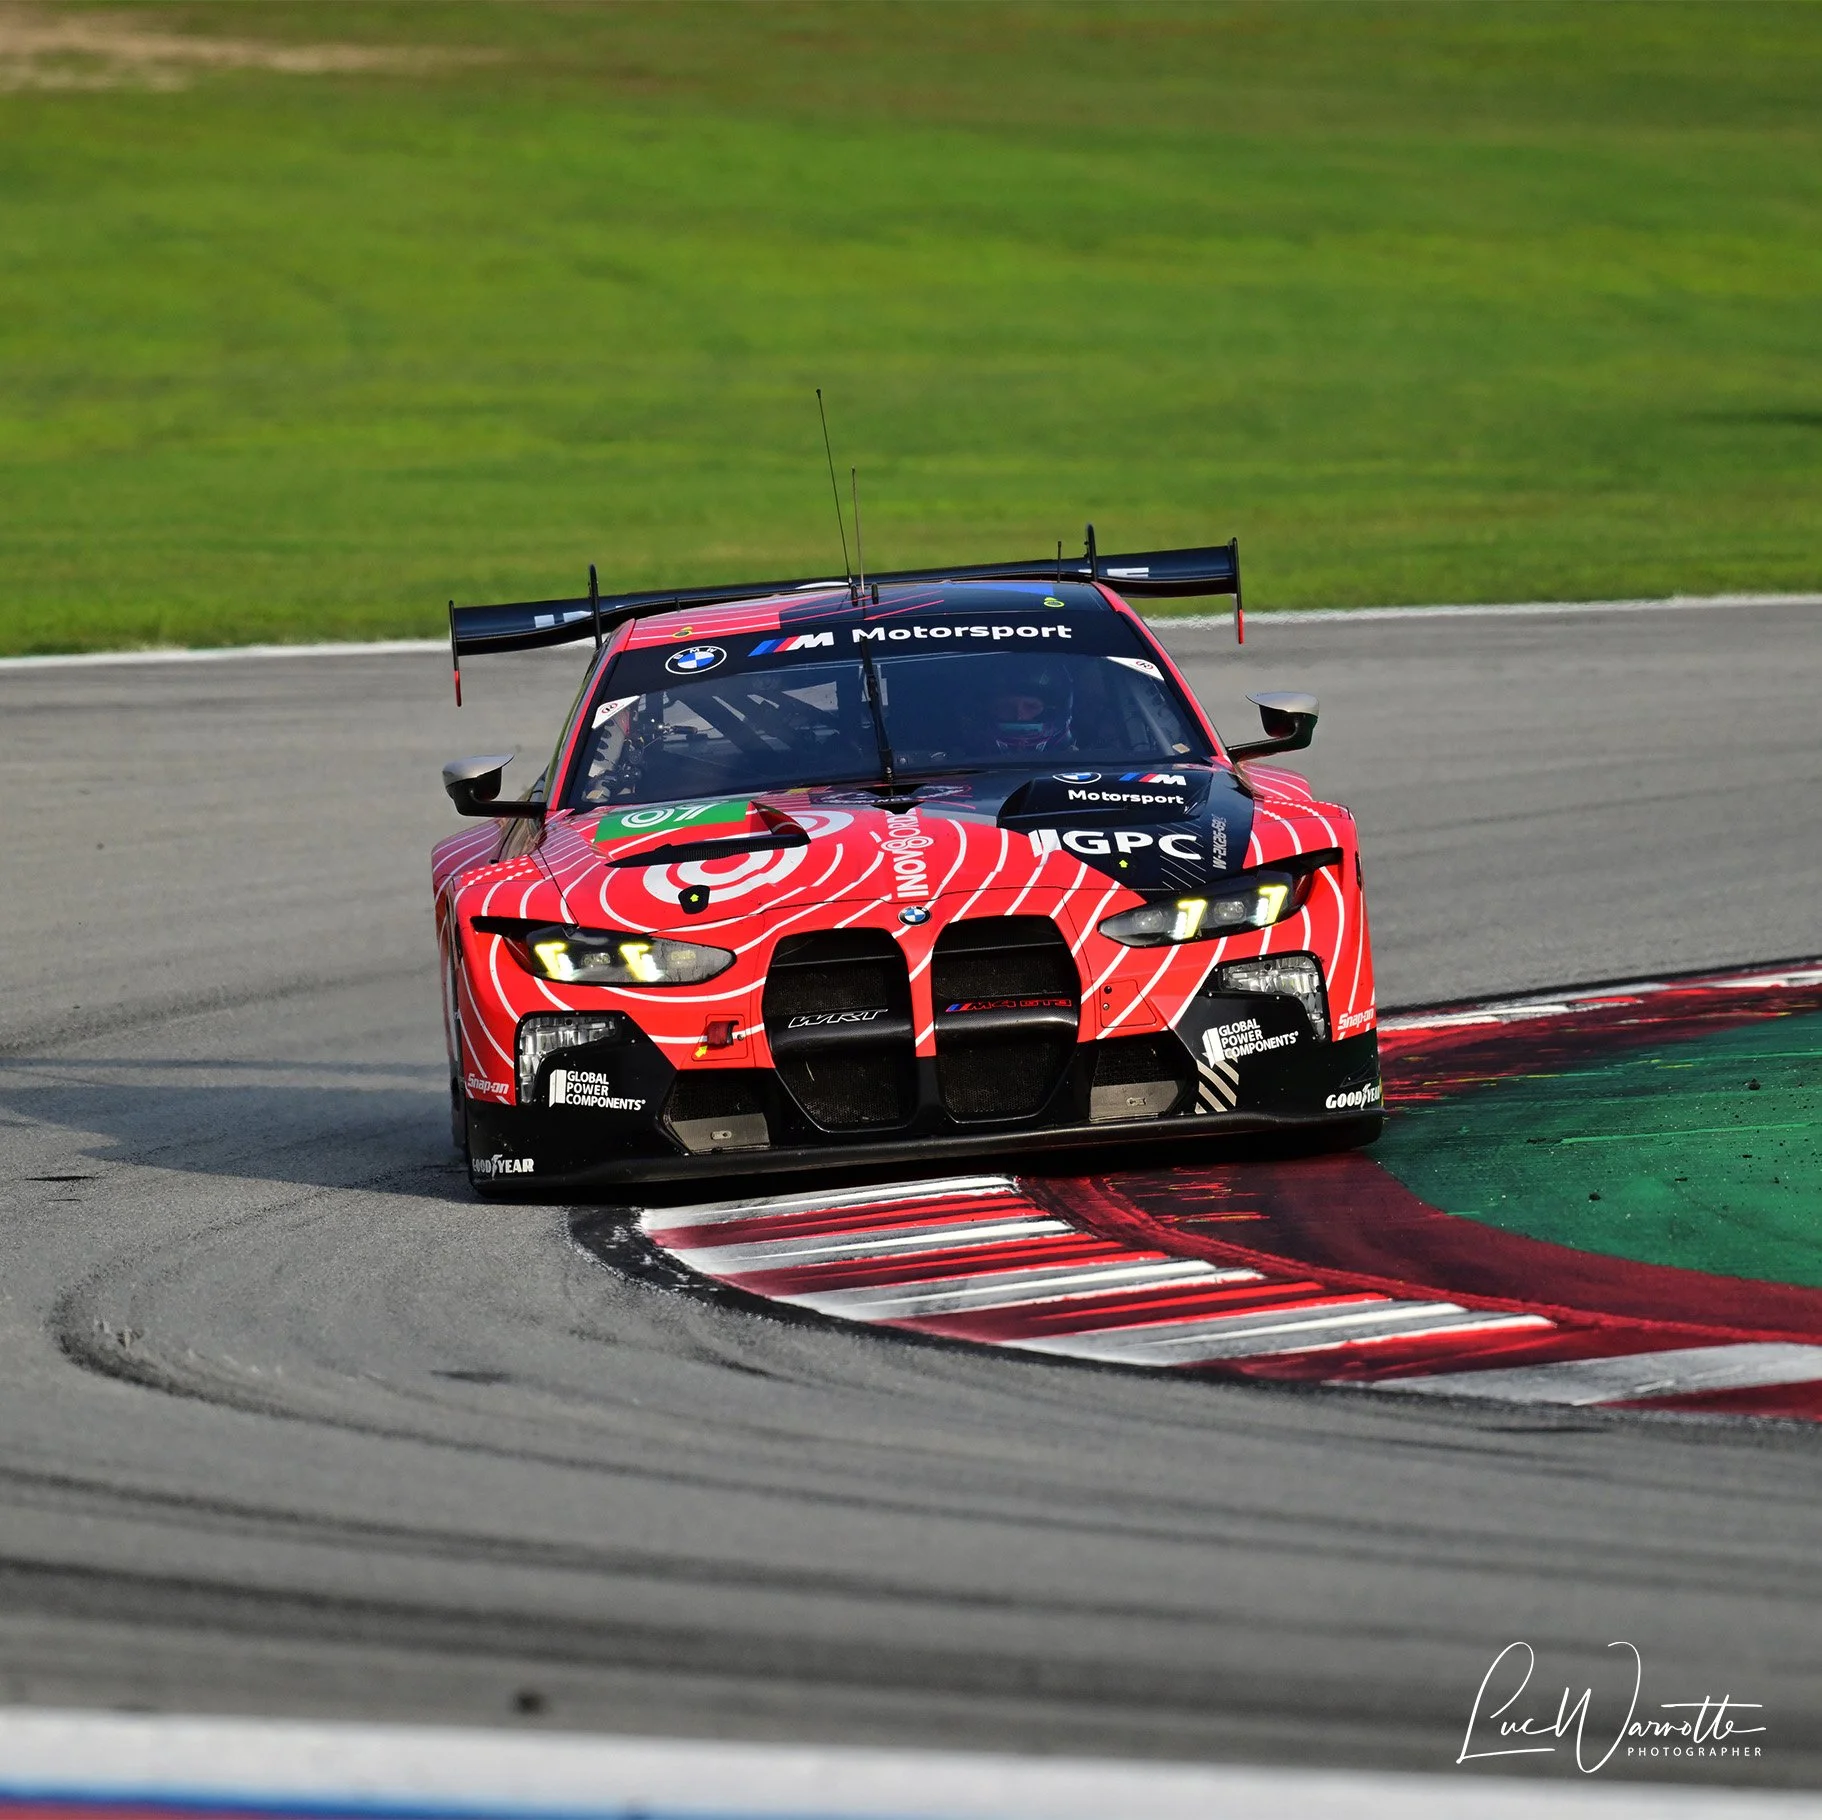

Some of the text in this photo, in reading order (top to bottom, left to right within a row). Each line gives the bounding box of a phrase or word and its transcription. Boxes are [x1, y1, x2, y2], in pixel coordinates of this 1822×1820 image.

[852, 624, 1073, 643] Motorsport
[1067, 789, 1185, 805] Motorsport
[1062, 830, 1202, 861] GPC
[788, 1008, 889, 1029] WRT
[1218, 1018, 1261, 1037] GLOBAL
[1337, 1008, 1375, 1031] Snap-on
[1221, 1029, 1263, 1047] POWER
[1223, 1032, 1298, 1059] COMPONENTS
[467, 1072, 509, 1095] Snap-on
[567, 1070, 609, 1085] GLOBAL
[567, 1082, 608, 1097] POWER
[566, 1093, 643, 1111] COMPONENTS
